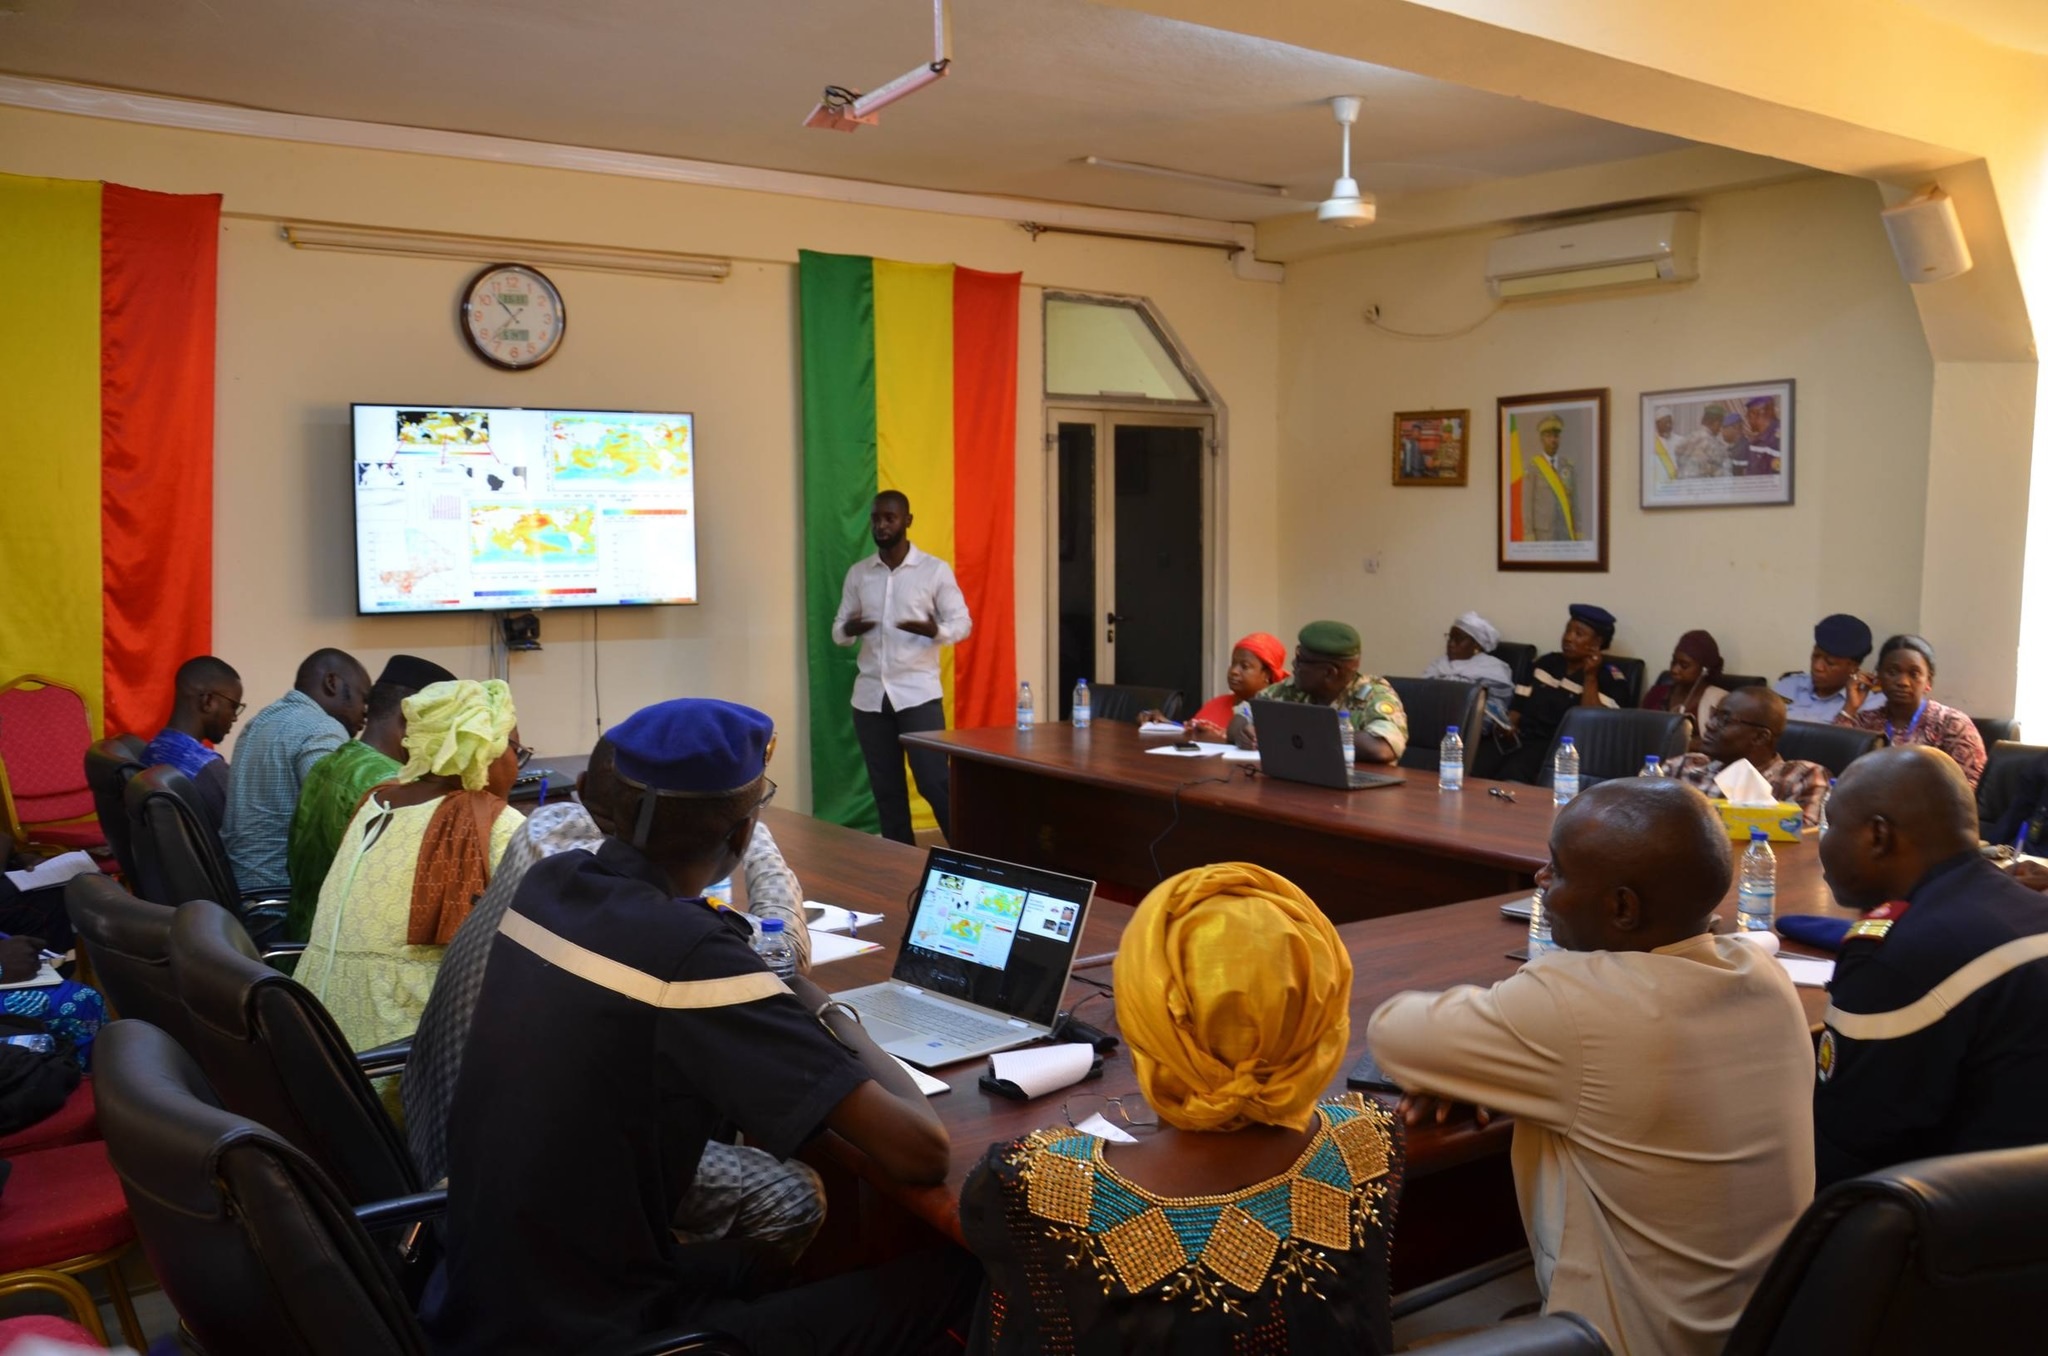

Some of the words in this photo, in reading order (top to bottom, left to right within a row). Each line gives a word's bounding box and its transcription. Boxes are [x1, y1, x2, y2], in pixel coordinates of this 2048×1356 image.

[492, 281, 501, 292] 11
[507, 277, 519, 288] 12
[480, 295, 491, 306] 10
[538, 296, 546, 307] 2
[474, 310, 483, 321] 9
[544, 314, 551, 325] 3
[480, 329, 488, 339] 8
[539, 331, 546, 340] 4
[492, 341, 501, 352] 7
[528, 343, 536, 353] 5
[510, 347, 518, 358] 6
